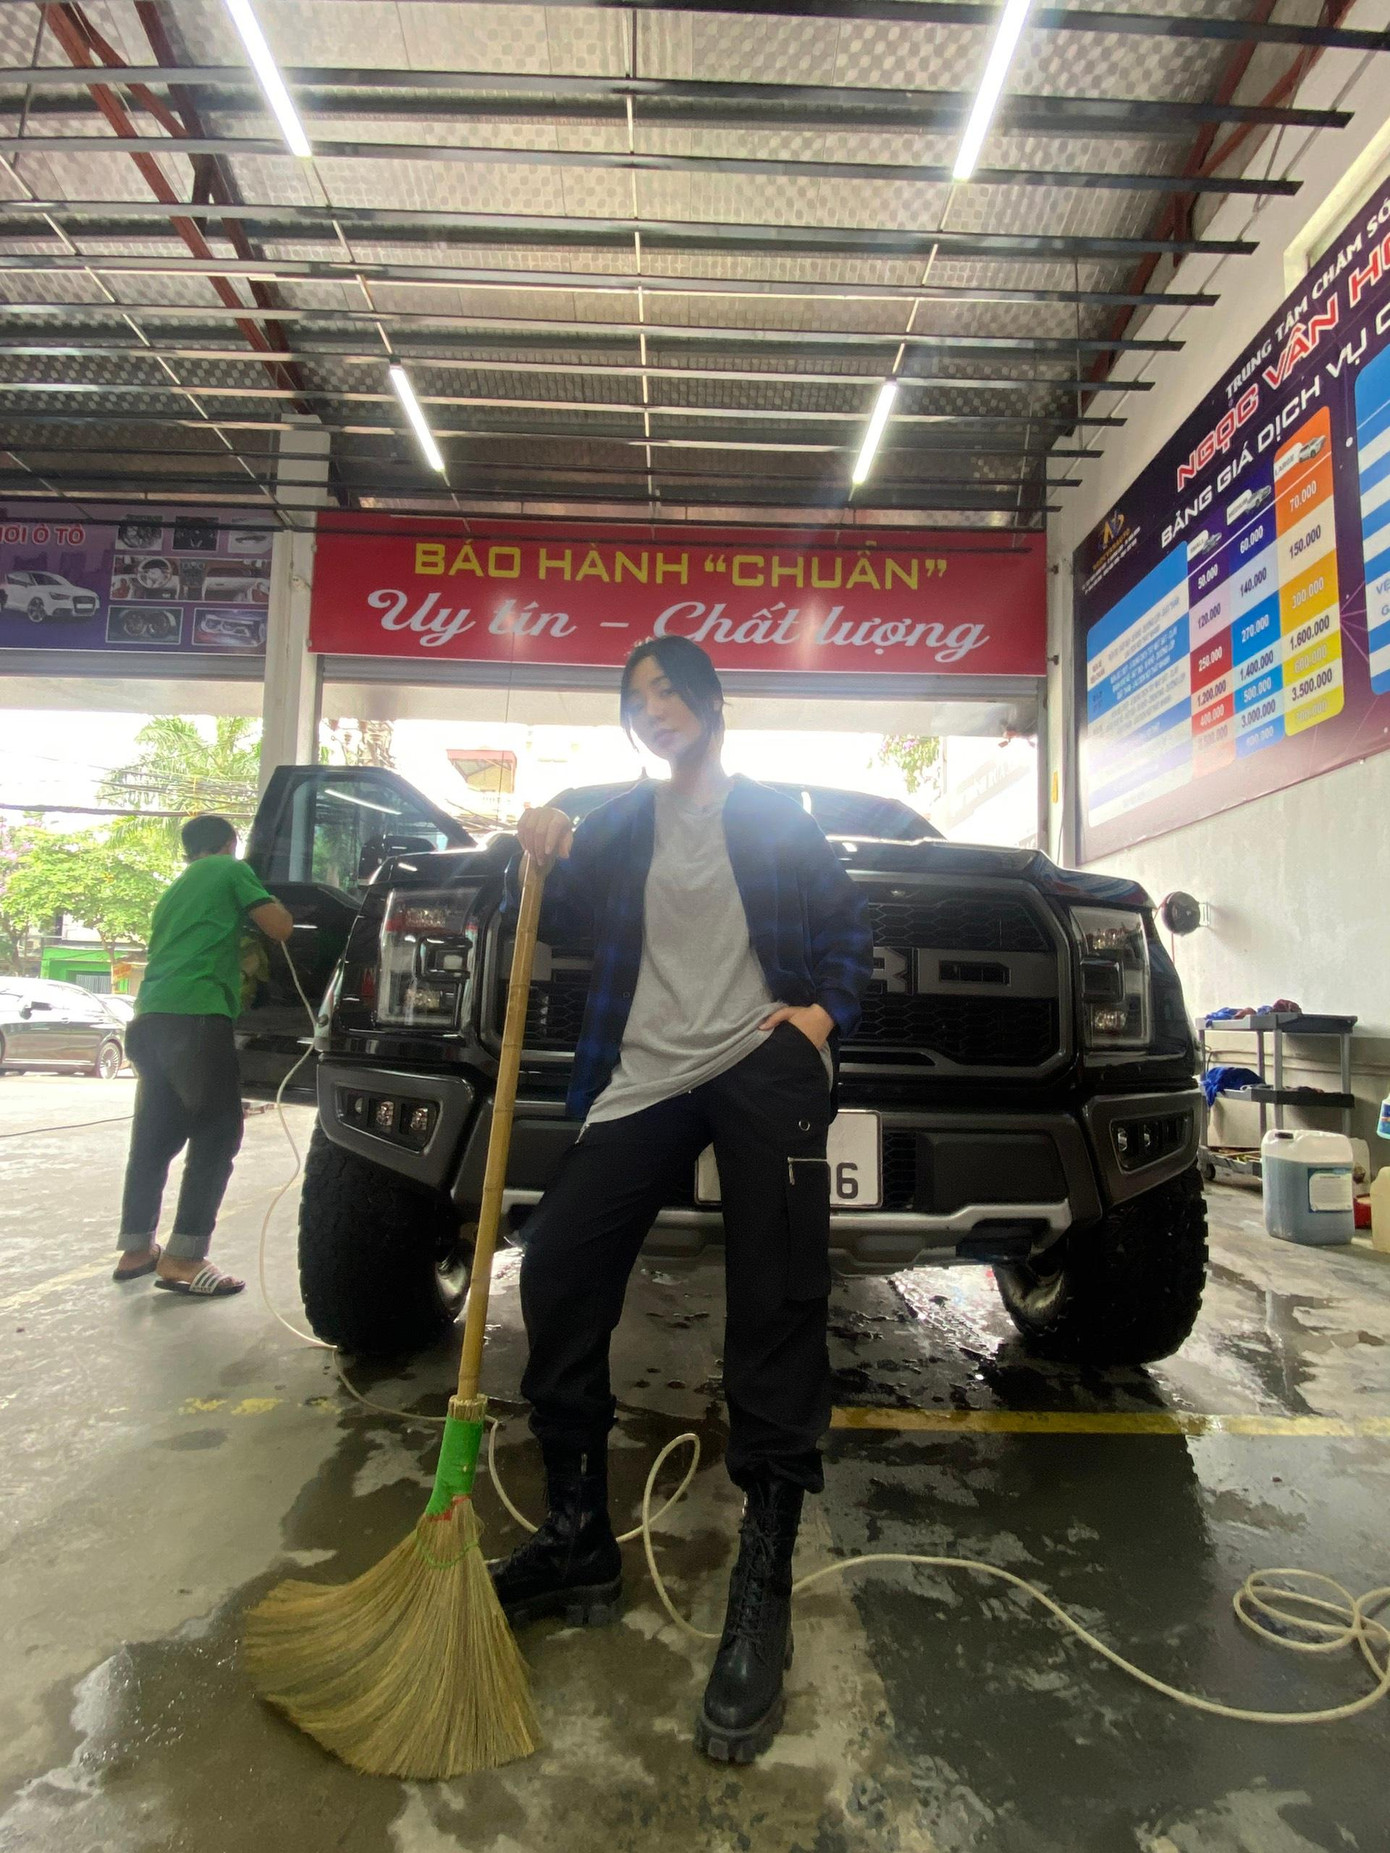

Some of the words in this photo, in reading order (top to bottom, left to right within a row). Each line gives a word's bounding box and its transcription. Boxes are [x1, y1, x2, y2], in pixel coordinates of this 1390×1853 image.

[1226, 339, 1272, 398] TRUNG
[1275, 296, 1308, 342] TÂM
[1161, 485, 1213, 549] BẢNG
[1217, 440, 1254, 492] GIÁ
[1257, 375, 1321, 453] DỊCH
[1326, 327, 1368, 378] VỤ
[1177, 383, 1259, 493] NGỌC
[1289, 480, 1317, 513] 70.000
[1240, 525, 1264, 554] 60.000
[1289, 525, 1322, 559] 150.000
[414, 539, 521, 579] BẢO
[538, 543, 689, 585] HÀNH
[1240, 567, 1267, 598] 140.000
[367, 589, 476, 647] Uy
[488, 598, 577, 638] tín
[653, 600, 802, 645] Chất
[813, 605, 991, 663] lượng
[1240, 614, 1270, 643] 270.000
[1289, 614, 1330, 651] 1.600.000
[1240, 650, 1274, 681] 1.400.000
[1197, 680, 1227, 707] 1.200.000
[1291, 668, 1333, 702] 3.500.000
[1241, 699, 1276, 729] 3.000.000
